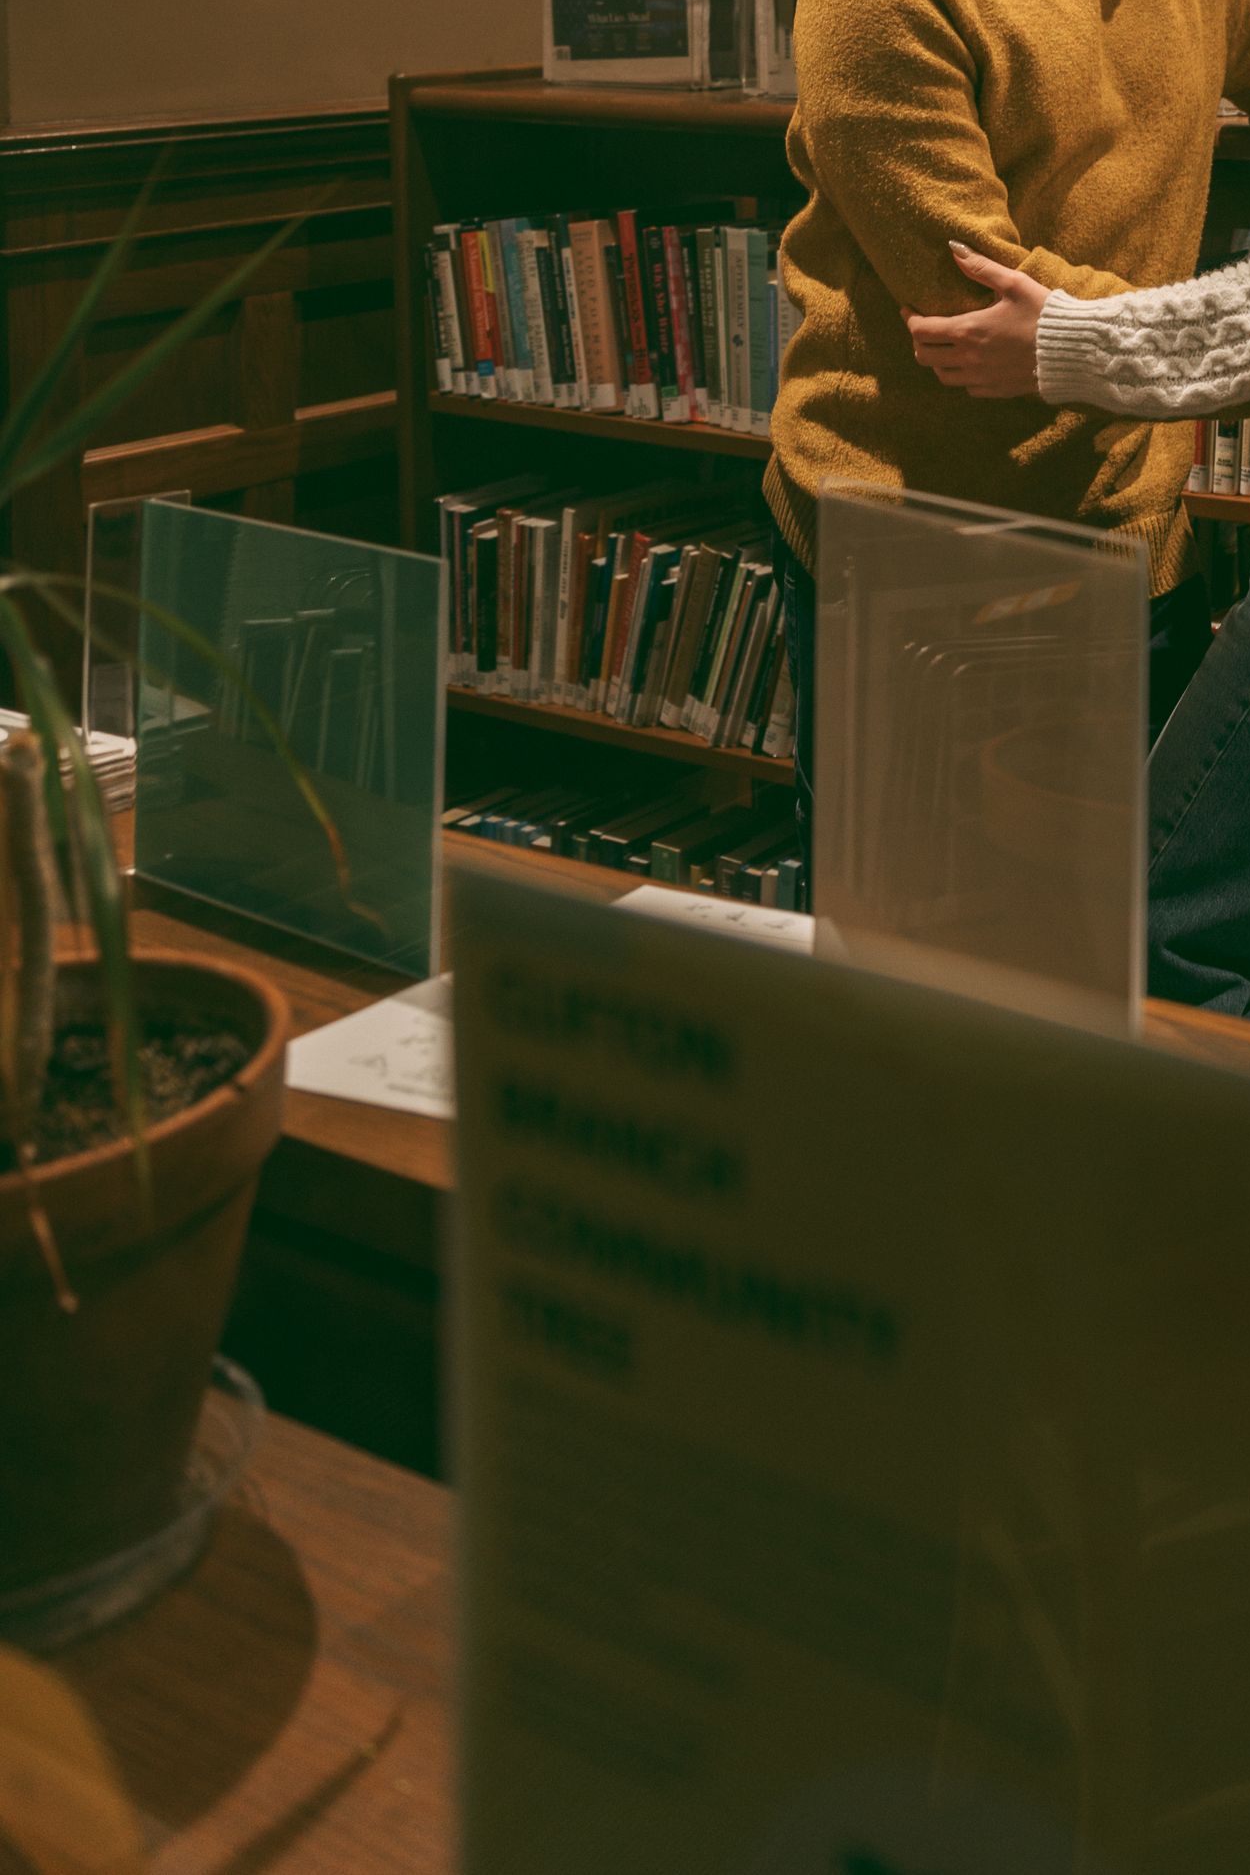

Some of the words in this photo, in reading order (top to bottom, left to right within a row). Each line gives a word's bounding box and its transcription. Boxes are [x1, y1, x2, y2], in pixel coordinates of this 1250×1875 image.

[703, 248, 711, 265] THE
[653, 262, 664, 288] Why
[655, 292, 666, 314] She
[706, 294, 713, 307] ON
[658, 317, 670, 355] Wrote
